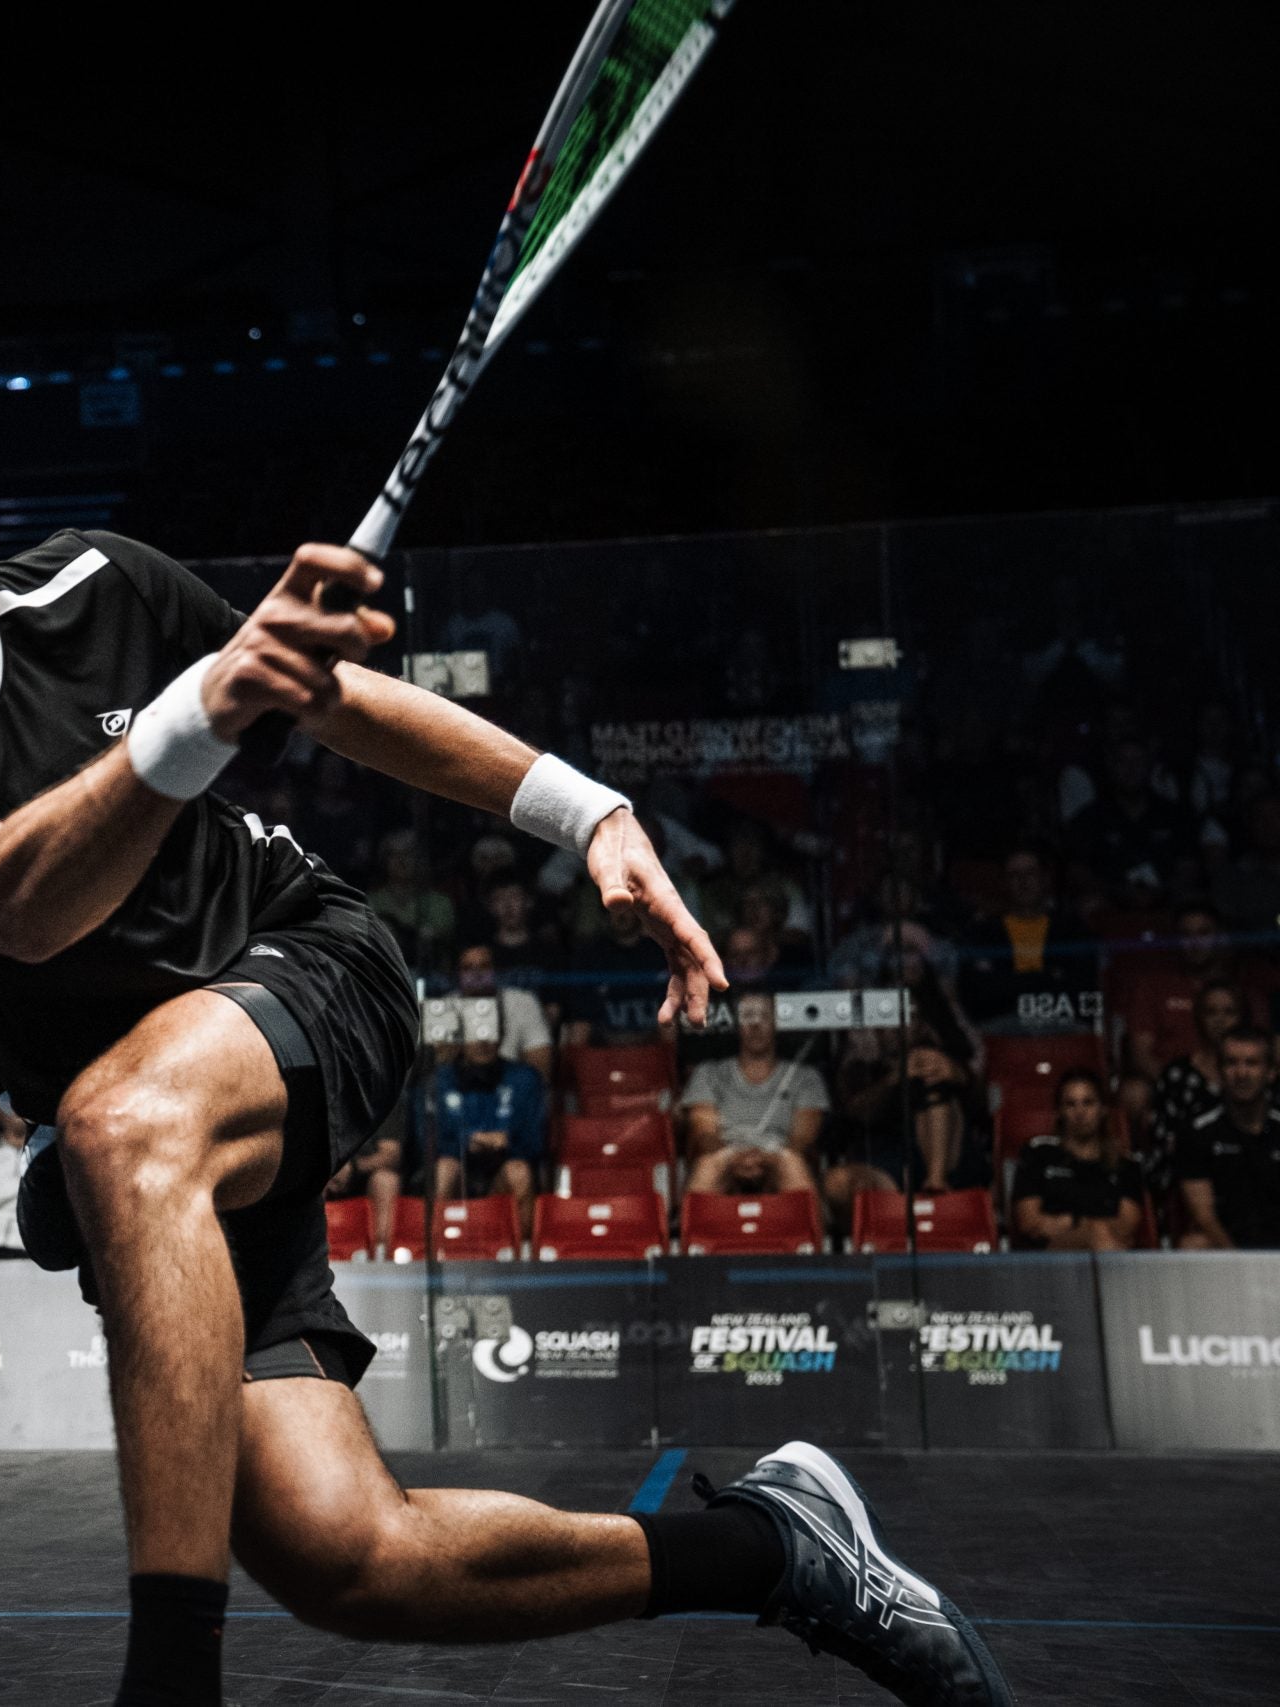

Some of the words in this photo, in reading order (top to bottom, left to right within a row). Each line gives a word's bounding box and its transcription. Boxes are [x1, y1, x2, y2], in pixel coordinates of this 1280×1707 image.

[711, 1312, 745, 1327] NEW
[746, 1312, 811, 1327] ZEALAND
[966, 1311, 1034, 1325] ZEALAND
[535, 1330, 620, 1351] SQUASH
[690, 1324, 838, 1353] FESTIVAL
[1138, 1325, 1280, 1368] Lucin
[722, 1351, 837, 1373] SQUASH
[943, 1351, 1061, 1373] SQUASH
